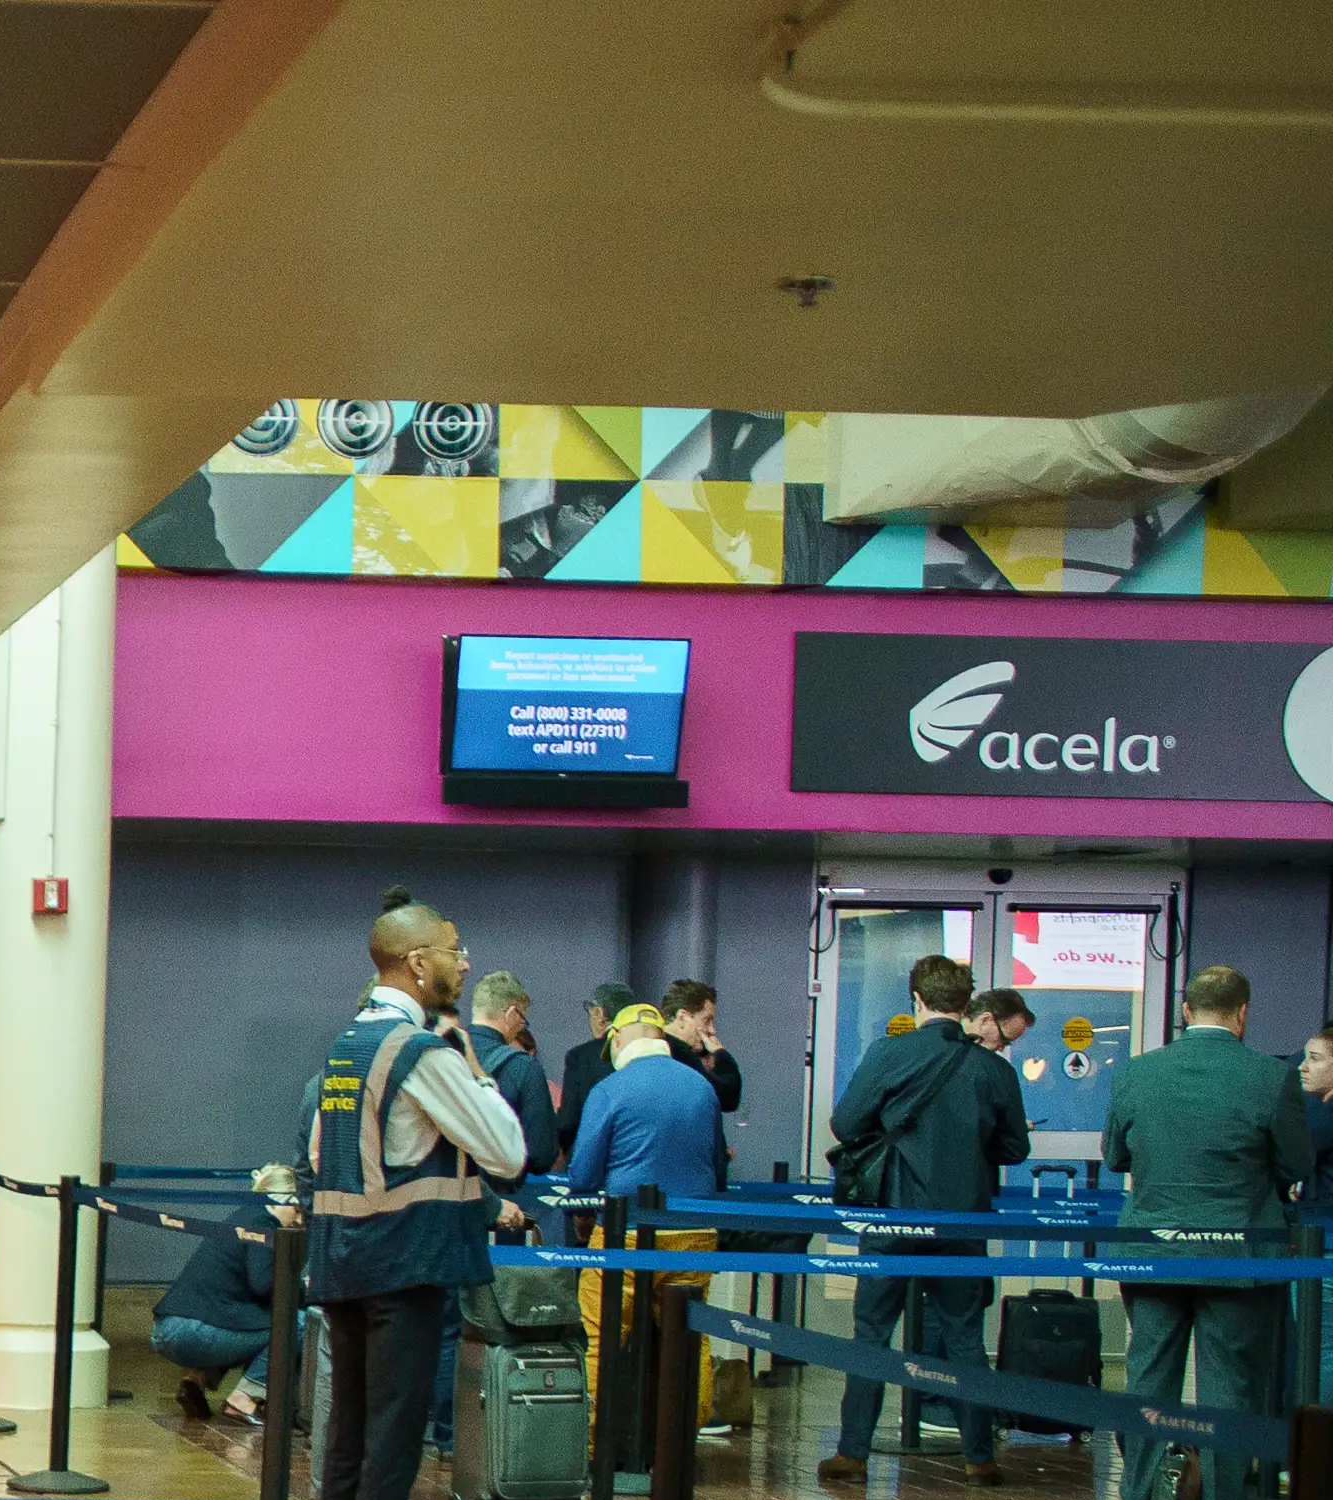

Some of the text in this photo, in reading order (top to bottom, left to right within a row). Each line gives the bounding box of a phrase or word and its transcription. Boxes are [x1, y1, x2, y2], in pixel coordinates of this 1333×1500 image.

[510, 706, 628, 722] Call (800) 331-0008
[508, 724, 627, 741] text APD11 (27311)
[533, 740, 597, 755] or call 911
[559, 1197, 606, 1207] AMTRA
[866, 1225, 935, 1236] AMTRAK
[1175, 1231, 1246, 1242] AMTRAK
[552, 1253, 606, 1263] AMTRAK
[827, 1261, 879, 1269] AMTRAK
[1101, 1264, 1154, 1273] AMTRAK
